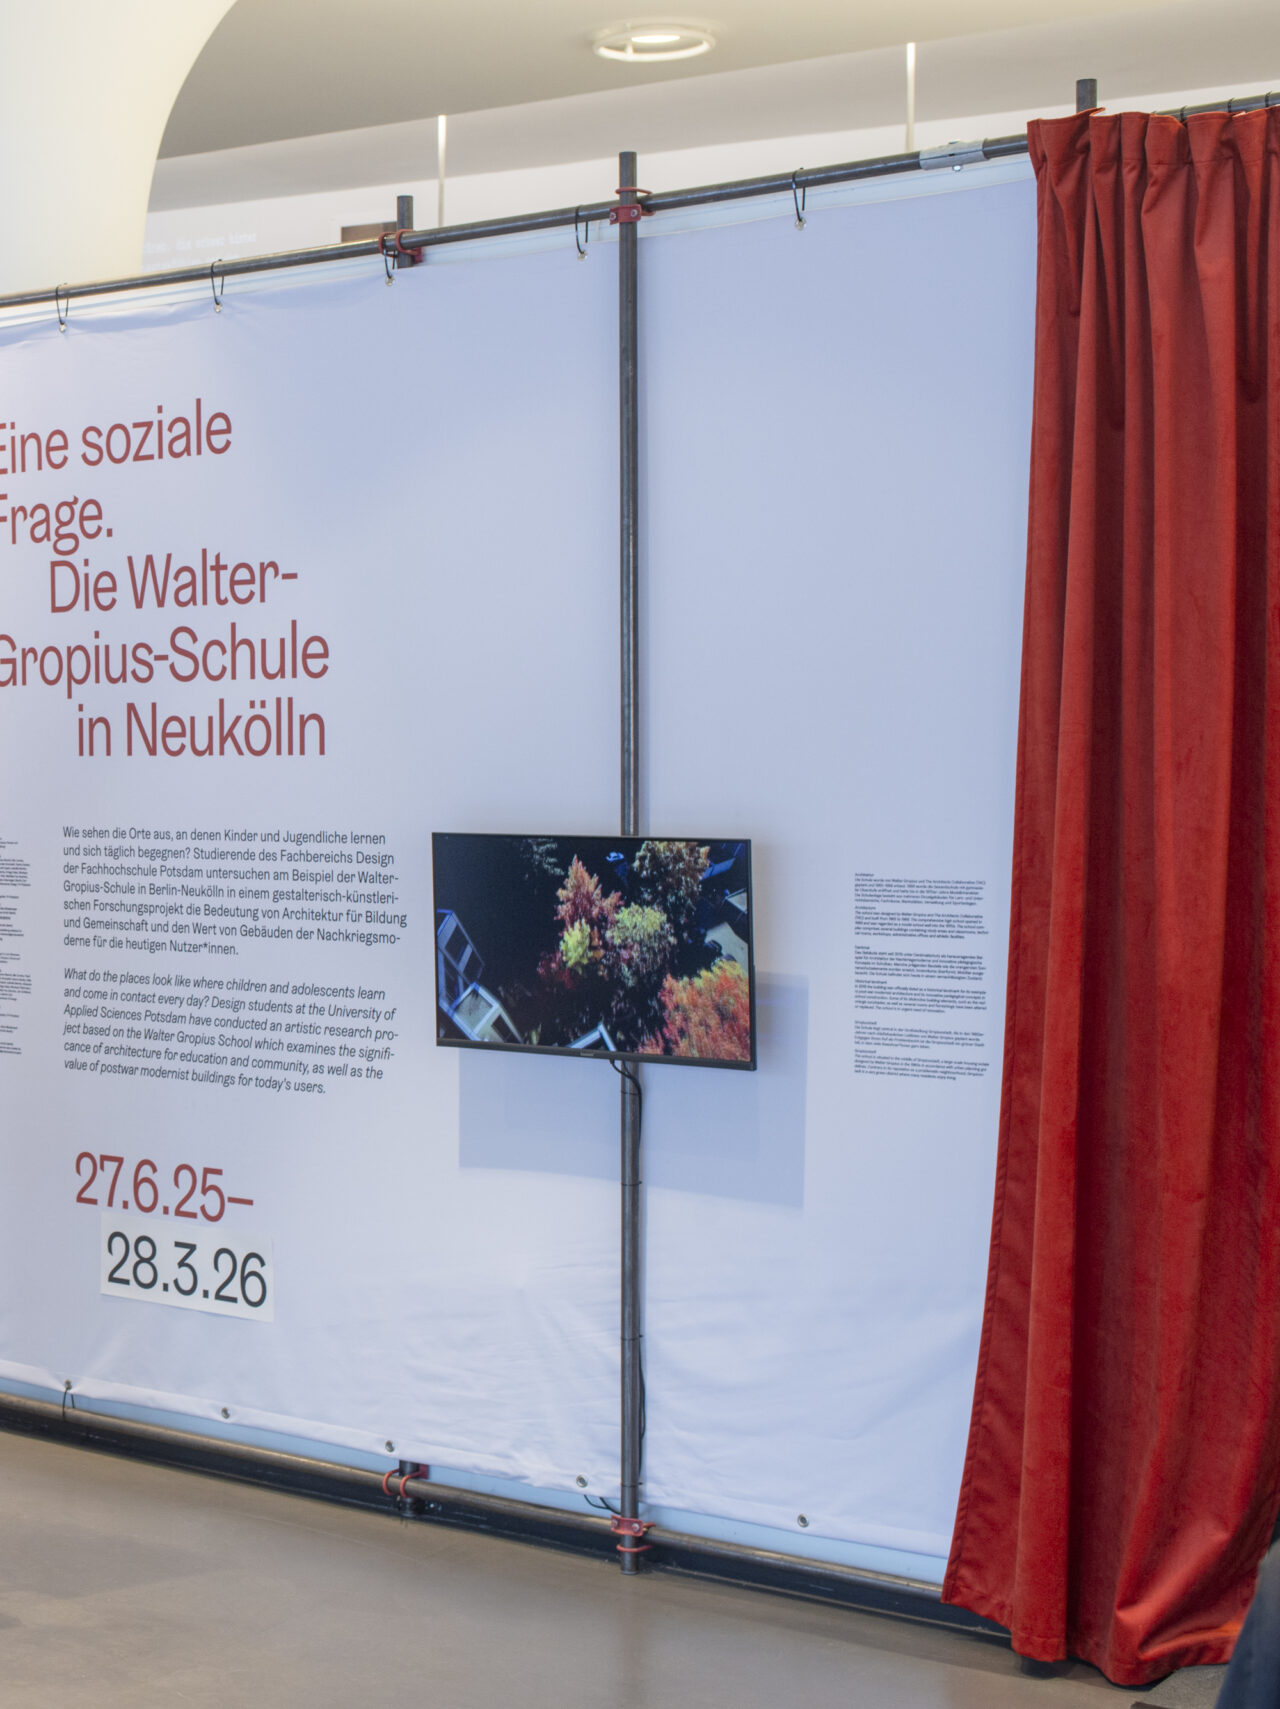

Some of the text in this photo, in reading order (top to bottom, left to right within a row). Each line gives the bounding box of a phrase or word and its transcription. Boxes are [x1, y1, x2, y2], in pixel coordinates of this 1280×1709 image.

[81, 398, 233, 467] soziale
[49, 548, 298, 614] Die Walter-
[77, 697, 326, 758] in Neukölln
[62, 826, 385, 846] Wie sehen die Orte aus, an denen Kinder und Jugendliche lernen
[63, 844, 394, 867] und sich täglich begegnen? Studierende des Fachbereichs Design
[63, 862, 398, 884] der Fachhochschule Potsdam untersuchen am Beispiel der Walter-
[63, 879, 398, 904] Gropius-Schule in Berlin-Neukölln in einem gestalterisch-künstleri-
[63, 898, 407, 928] schen Forschungsprojekt die Bedeutung von Architektur für Bildung
[63, 916, 400, 946] und Gemeinschaft und den Wert von Gebäuden der Nachkriegsmo-
[63, 934, 90, 946] derne
[92, 934, 107, 947] für
[108, 936, 123, 948] die
[125, 937, 166, 953] heutigen
[64, 968, 385, 1000] What do the places look like where children and adolescents learn
[63, 986, 396, 1022] and come in contact every day? Design students at the University of
[63, 1003, 398, 1042] Applied Sciences Potsdam have conducted an artistic research pro-
[62, 1022, 394, 1062] ject based on the Walter Gropius School which examines the signifi-
[64, 1042, 383, 1079] cance of architecture for education and community, as well as the
[64, 1058, 325, 1093] value of postwar modernist buildings for today's users.
[75, 1151, 254, 1222] 27.6.25–
[107, 1231, 267, 1308] 28.3.26
